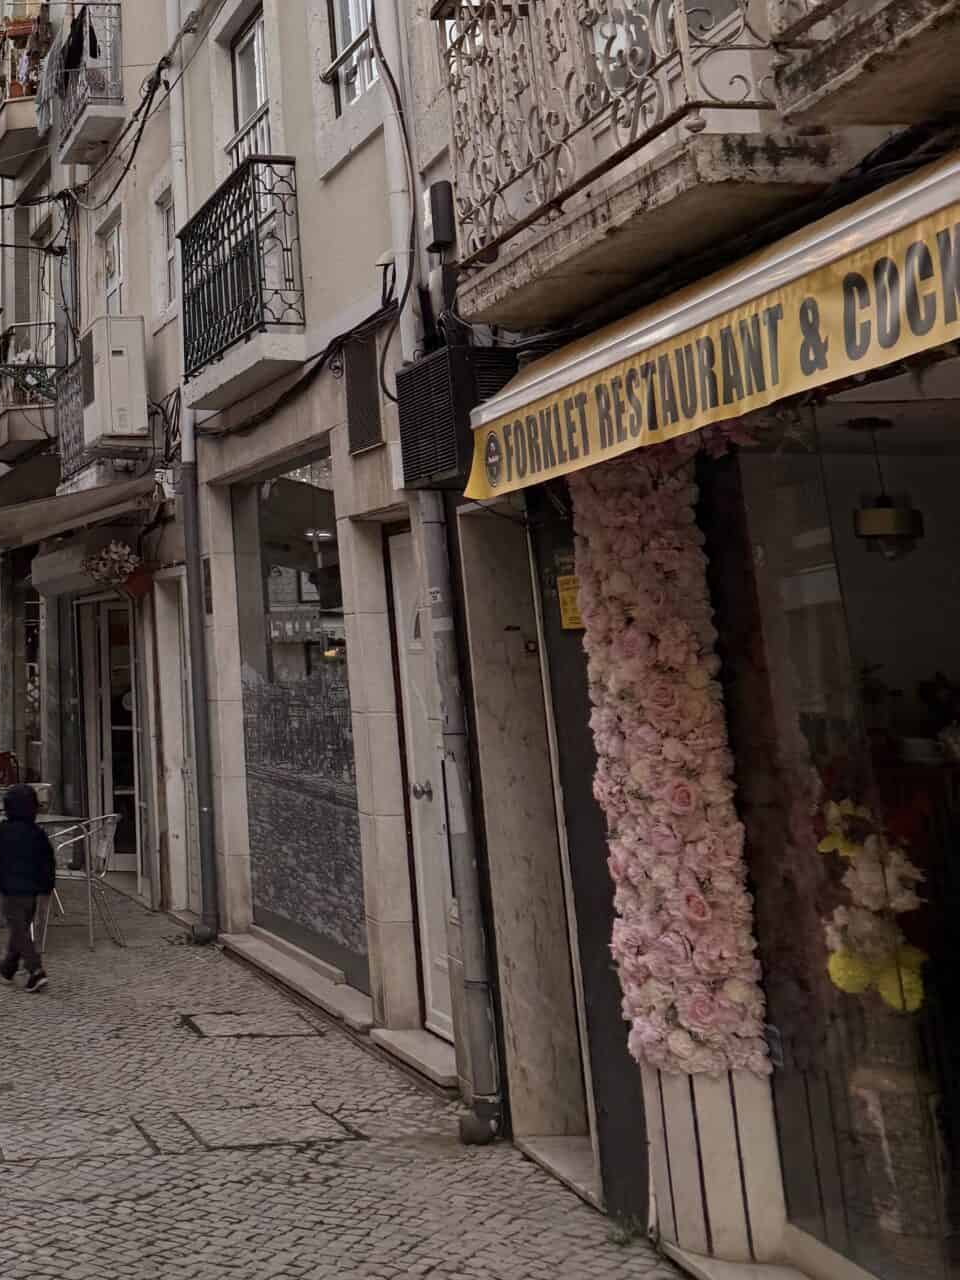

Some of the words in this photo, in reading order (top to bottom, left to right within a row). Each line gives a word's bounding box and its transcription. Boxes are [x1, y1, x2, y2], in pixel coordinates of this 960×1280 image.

[501, 391, 590, 482] FORKLET
[594, 302, 784, 450] RESTAURANT
[798, 296, 829, 377] &
